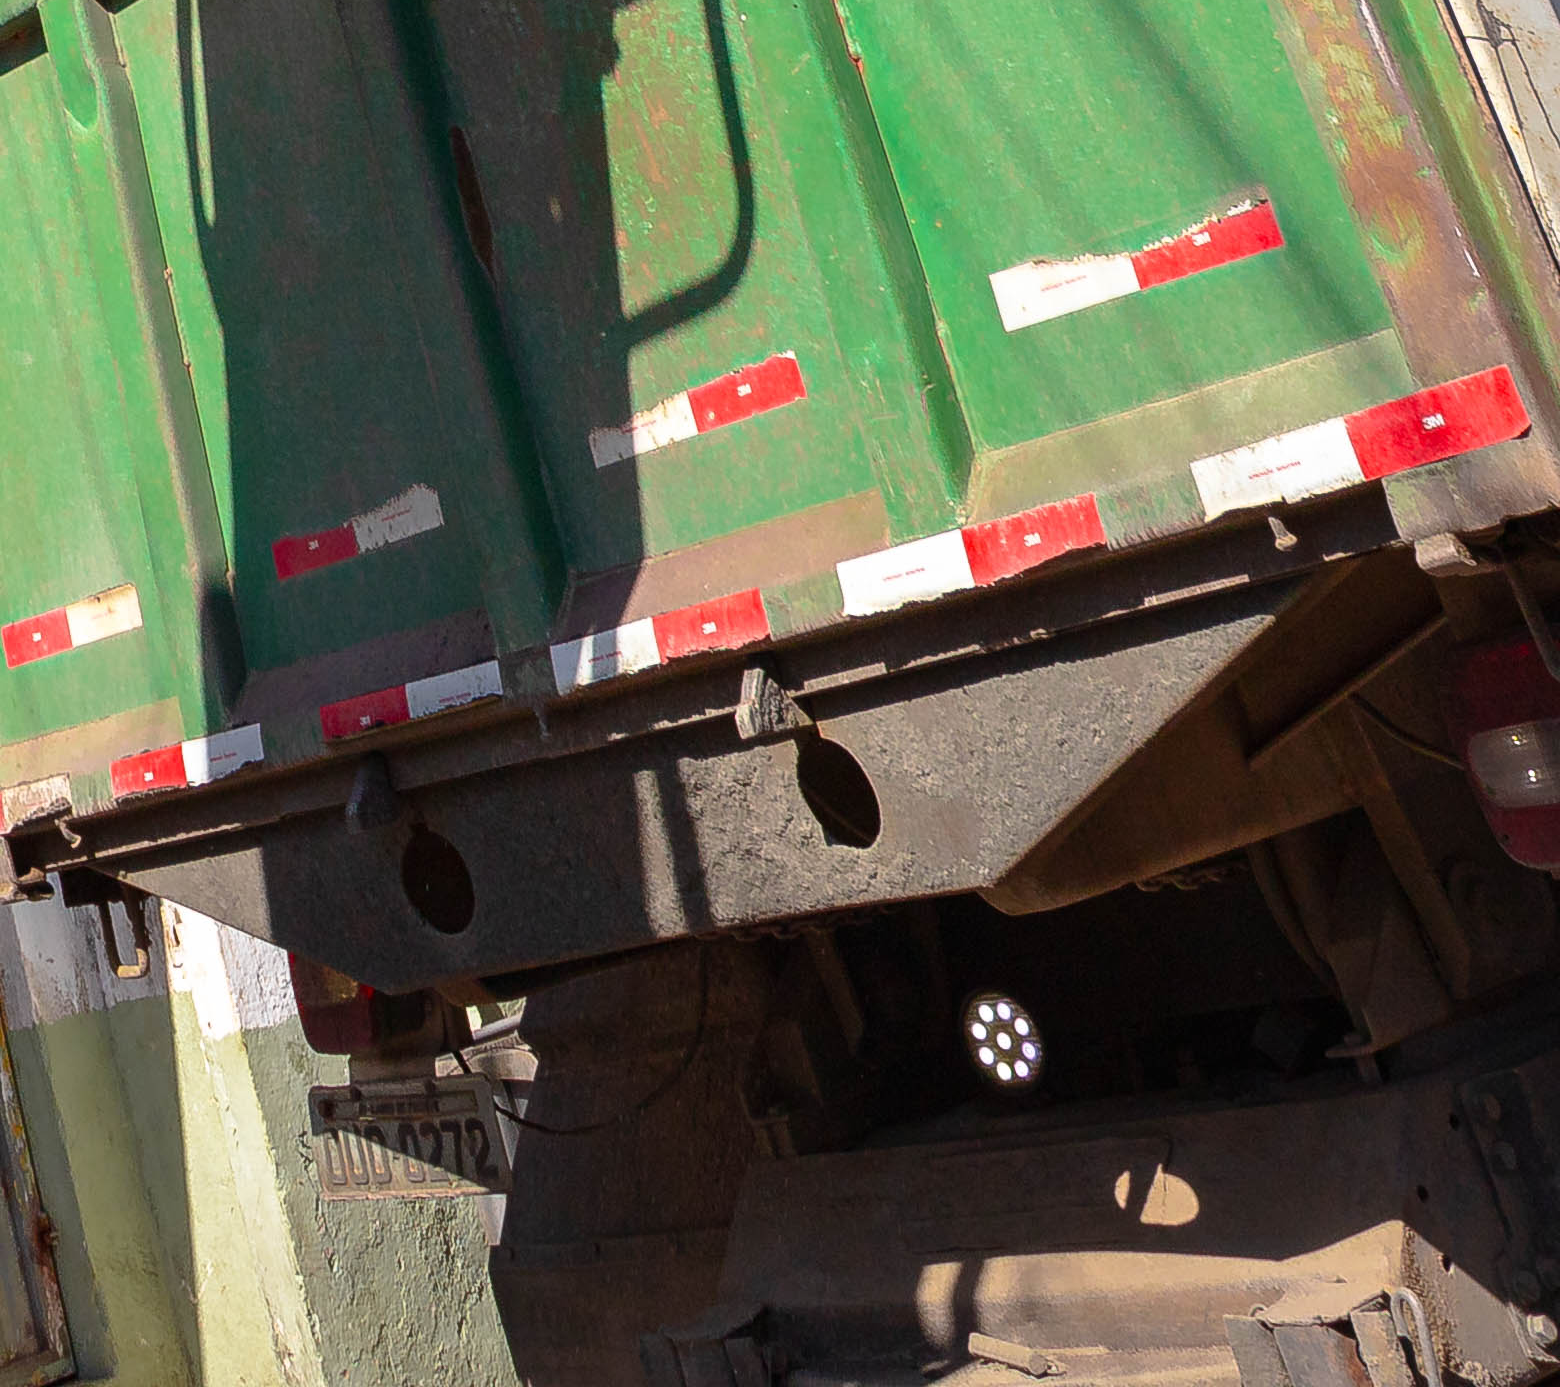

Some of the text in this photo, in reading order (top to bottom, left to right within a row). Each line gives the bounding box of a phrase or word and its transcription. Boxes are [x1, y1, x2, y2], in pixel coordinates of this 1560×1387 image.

[1191, 231, 1211, 246] 3M
[1421, 413, 1446, 430] 3M
[1024, 532, 1042, 547] 3M
